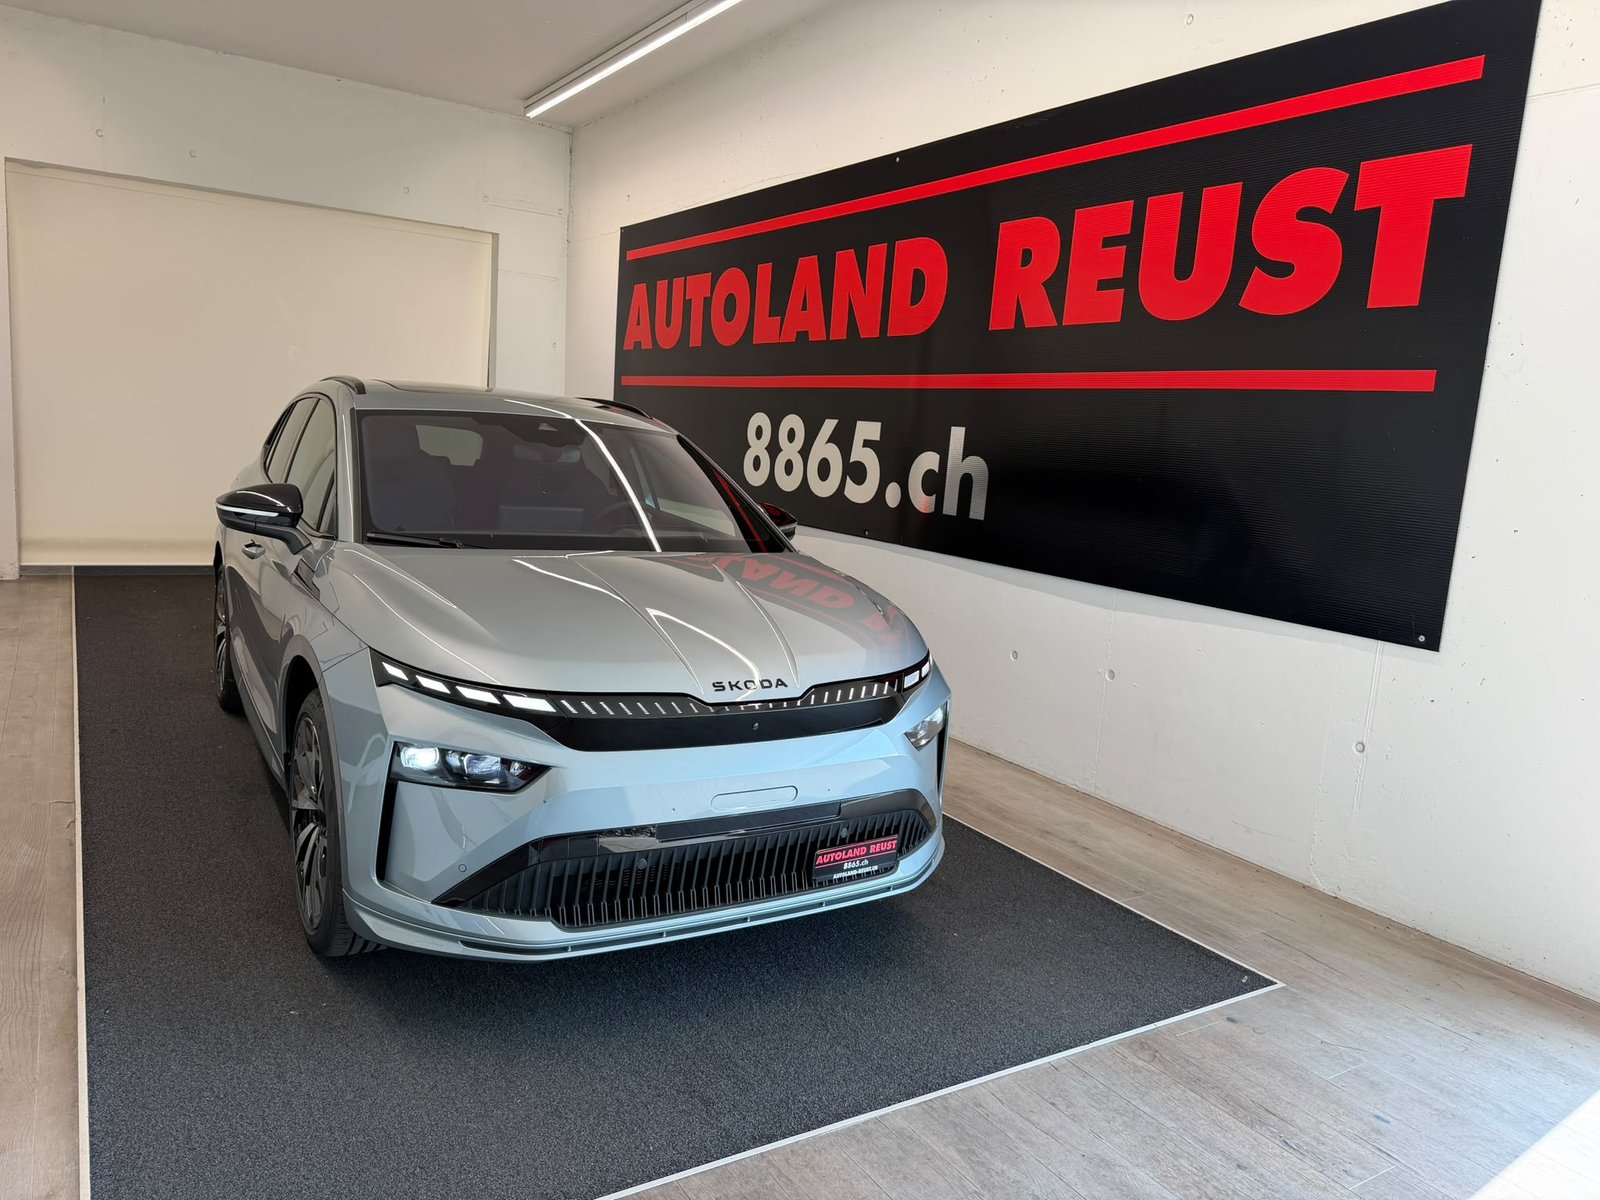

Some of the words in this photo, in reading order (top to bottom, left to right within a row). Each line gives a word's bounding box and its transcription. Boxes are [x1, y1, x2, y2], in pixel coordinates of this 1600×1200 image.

[623, 237, 949, 350] AUTOLAND
[988, 144, 1473, 331] REUST
[743, 411, 990, 521] 8865.ch
[815, 847, 867, 865] AUTOLAND
[869, 840, 897, 853] REUST
[843, 859, 869, 870] 8865.ch
